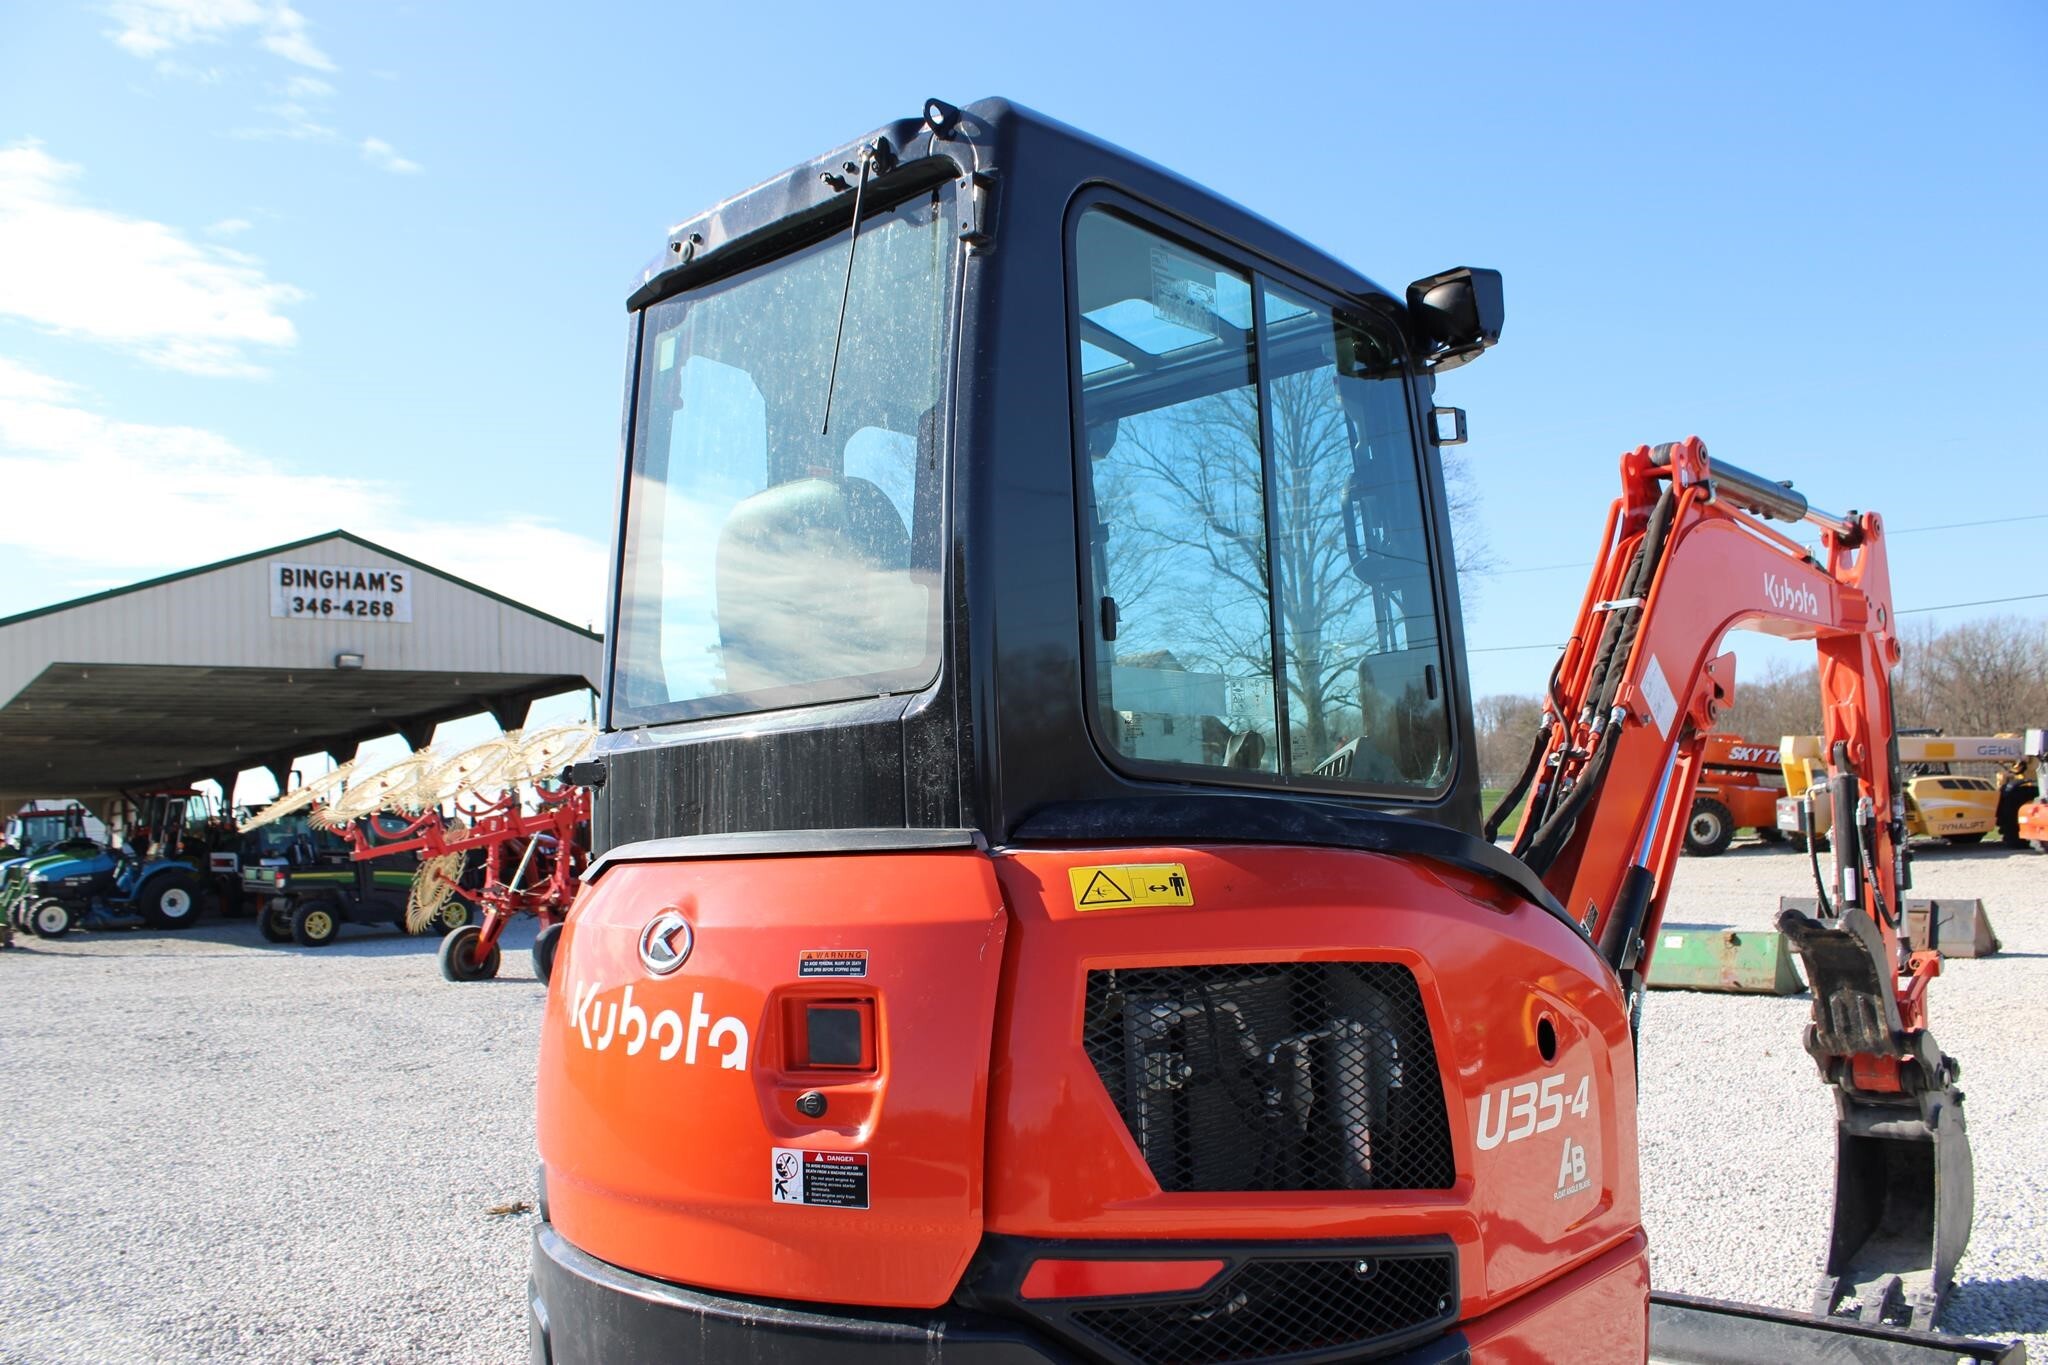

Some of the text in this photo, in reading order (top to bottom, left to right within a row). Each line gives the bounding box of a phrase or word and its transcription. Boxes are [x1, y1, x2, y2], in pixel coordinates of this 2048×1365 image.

[280, 567, 403, 593] BINGHAM'S
[292, 596, 394, 617] 346-4268
[1763, 572, 1818, 616] Kubota
[1728, 746, 1764, 762] SKY
[816, 951, 862, 959] WARNING
[570, 979, 749, 1071] Kubota
[1476, 1073, 1589, 1151] U35-4
